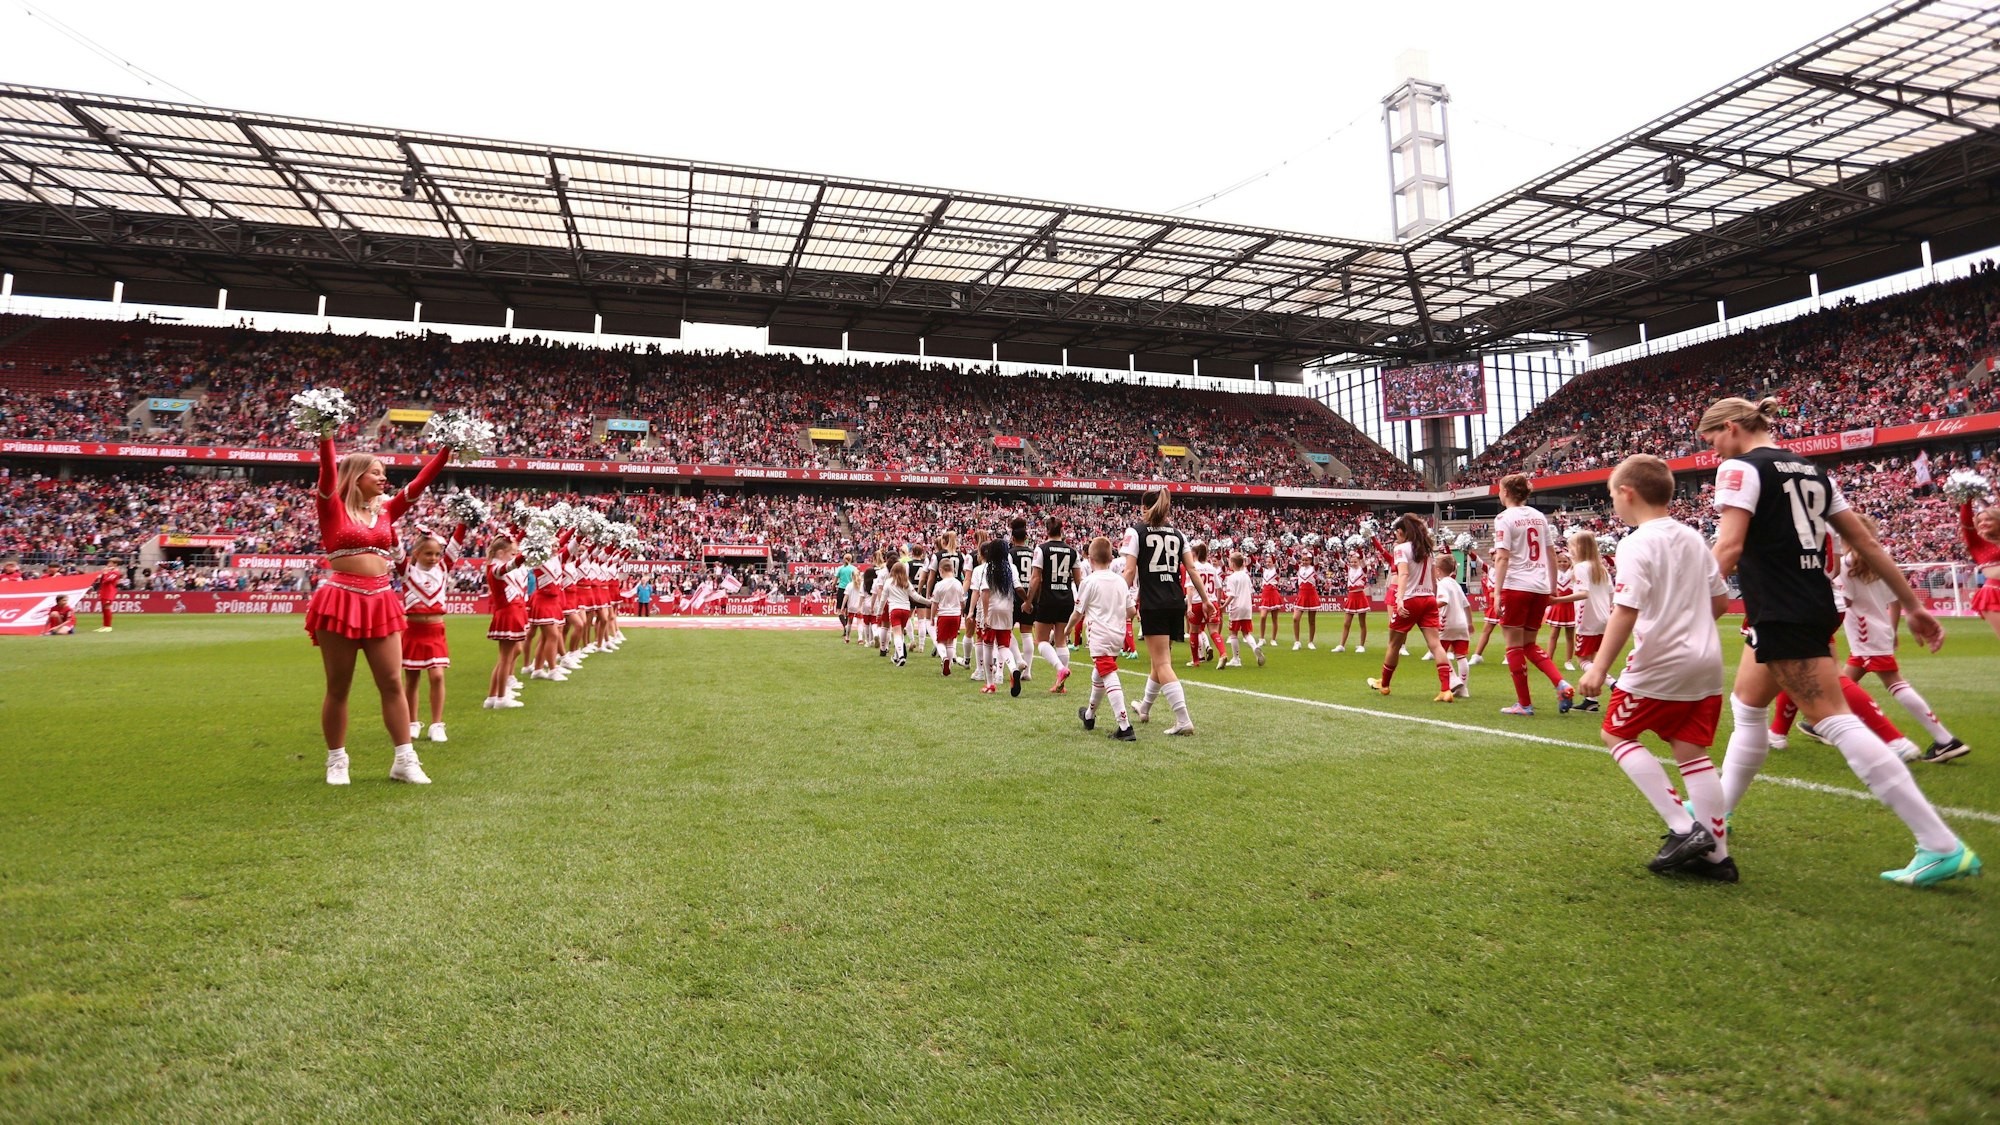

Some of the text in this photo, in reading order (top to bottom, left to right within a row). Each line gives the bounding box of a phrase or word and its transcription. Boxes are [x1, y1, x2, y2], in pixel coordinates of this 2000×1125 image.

[3, 442, 82, 455] SPÜRBAR ANDERS.
[118, 446, 158, 456] SPÜRBAR
[228, 450, 300, 461] SPÜRBAR ANDERS.
[527, 461, 560, 471] SPÜRBAR
[619, 463, 680, 475] SPÜRBAR ANDERS.
[734, 468, 764, 478] SPÜRBAR
[819, 471, 875, 482] SPÜRBAR ANDERS.
[900, 474, 927, 483] SPÜRBAR
[978, 477, 1030, 487] SPÜRBAR ANDERS.
[1052, 479, 1078, 489] SPÜRBAR
[1123, 482, 1147, 491] SPÜRBAR
[1190, 485, 1214, 493] SPÜRBAR
[1782, 478, 1826, 552] 18
[1527, 527, 1540, 562] 6
[1146, 534, 1180, 573] 28
[238, 556, 282, 568] SPÜRBAR
[1021, 556, 1032, 582] 9
[1050, 553, 1070, 583] 14
[215, 599, 268, 613] SPÜRBAR
